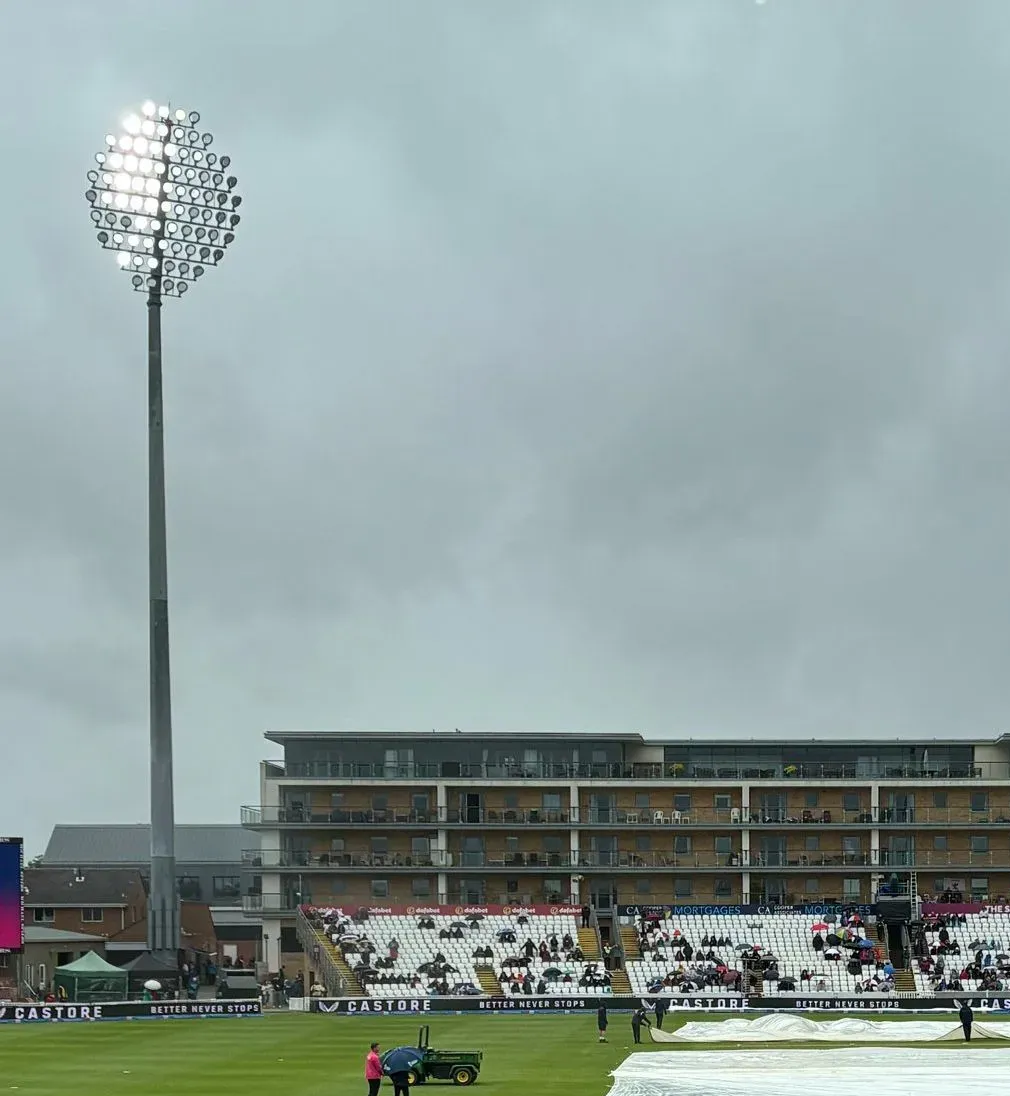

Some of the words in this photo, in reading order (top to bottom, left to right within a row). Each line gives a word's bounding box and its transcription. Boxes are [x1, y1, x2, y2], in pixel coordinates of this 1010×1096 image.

[626, 906, 640, 914] CA
[674, 906, 741, 914] MORTGAGES
[757, 906, 771, 914] CA
[804, 906, 870, 914] MORTGES
[985, 905, 1003, 913] THE
[347, 1000, 431, 1011] CASTORE
[479, 1000, 515, 1008] BETTER
[520, 1000, 550, 1008] NEVER
[554, 1000, 585, 1008] STOPS
[670, 999, 749, 1008] CASTORE
[795, 1000, 832, 1008] BETTER
[835, 1000, 865, 1008] NEVER
[869, 1000, 899, 1008] STOPS
[15, 1006, 102, 1019] CASTORE
[150, 1005, 187, 1014] BETTER
[191, 1004, 223, 1013] NEVER
[228, 1003, 259, 1012] STOPS
